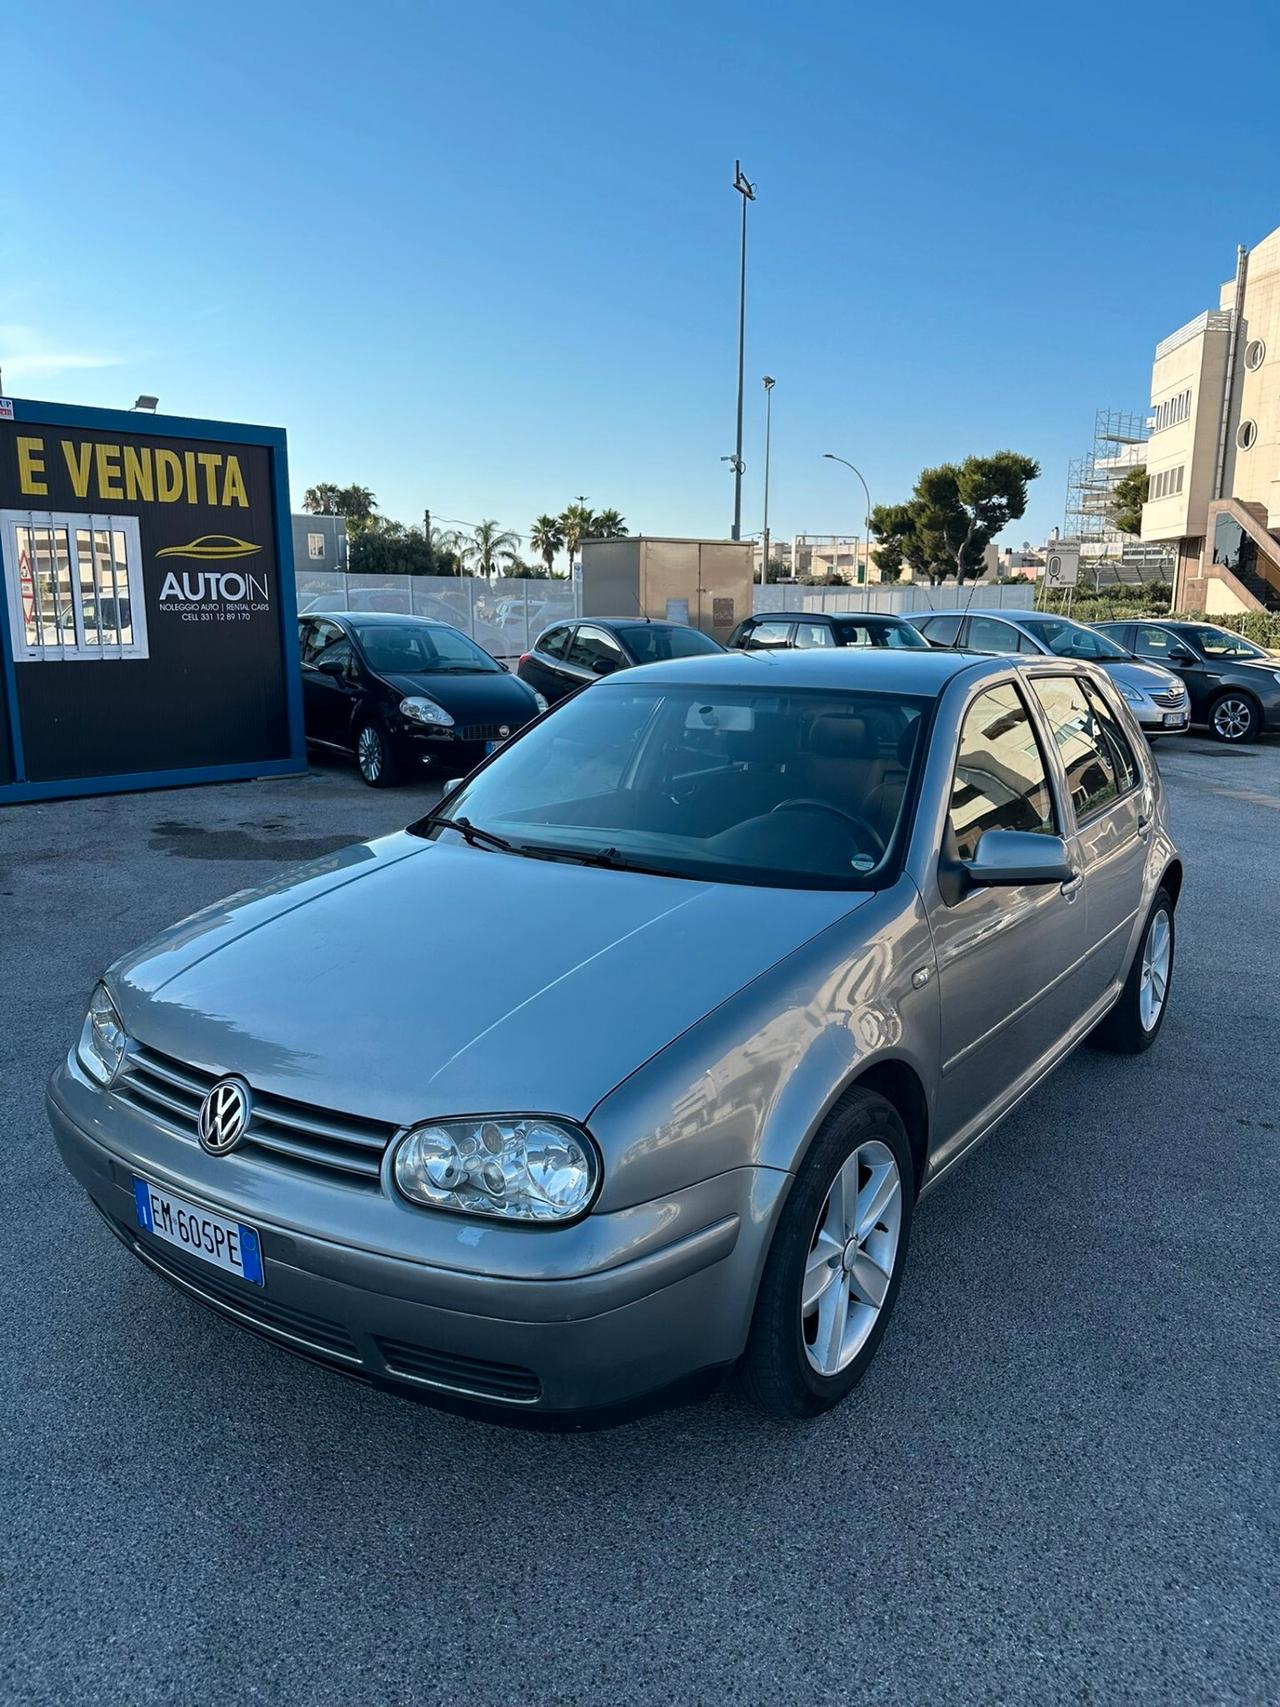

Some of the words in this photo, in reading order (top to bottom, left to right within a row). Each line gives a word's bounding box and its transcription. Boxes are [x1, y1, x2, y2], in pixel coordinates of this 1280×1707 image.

[16, 436, 49, 496] E
[60, 440, 250, 508] VENDITA
[159, 572, 269, 601] AUTOIN
[159, 603, 200, 611] NOLEGGIO
[200, 603, 220, 611] AUTO
[226, 603, 250, 611] RENTAL
[250, 603, 270, 611] CARS
[181, 613, 199, 621] CELL
[200, 613, 214, 621] 331
[216, 613, 225, 621] 12
[226, 613, 236, 621] 89
[238, 613, 251, 621] 170
